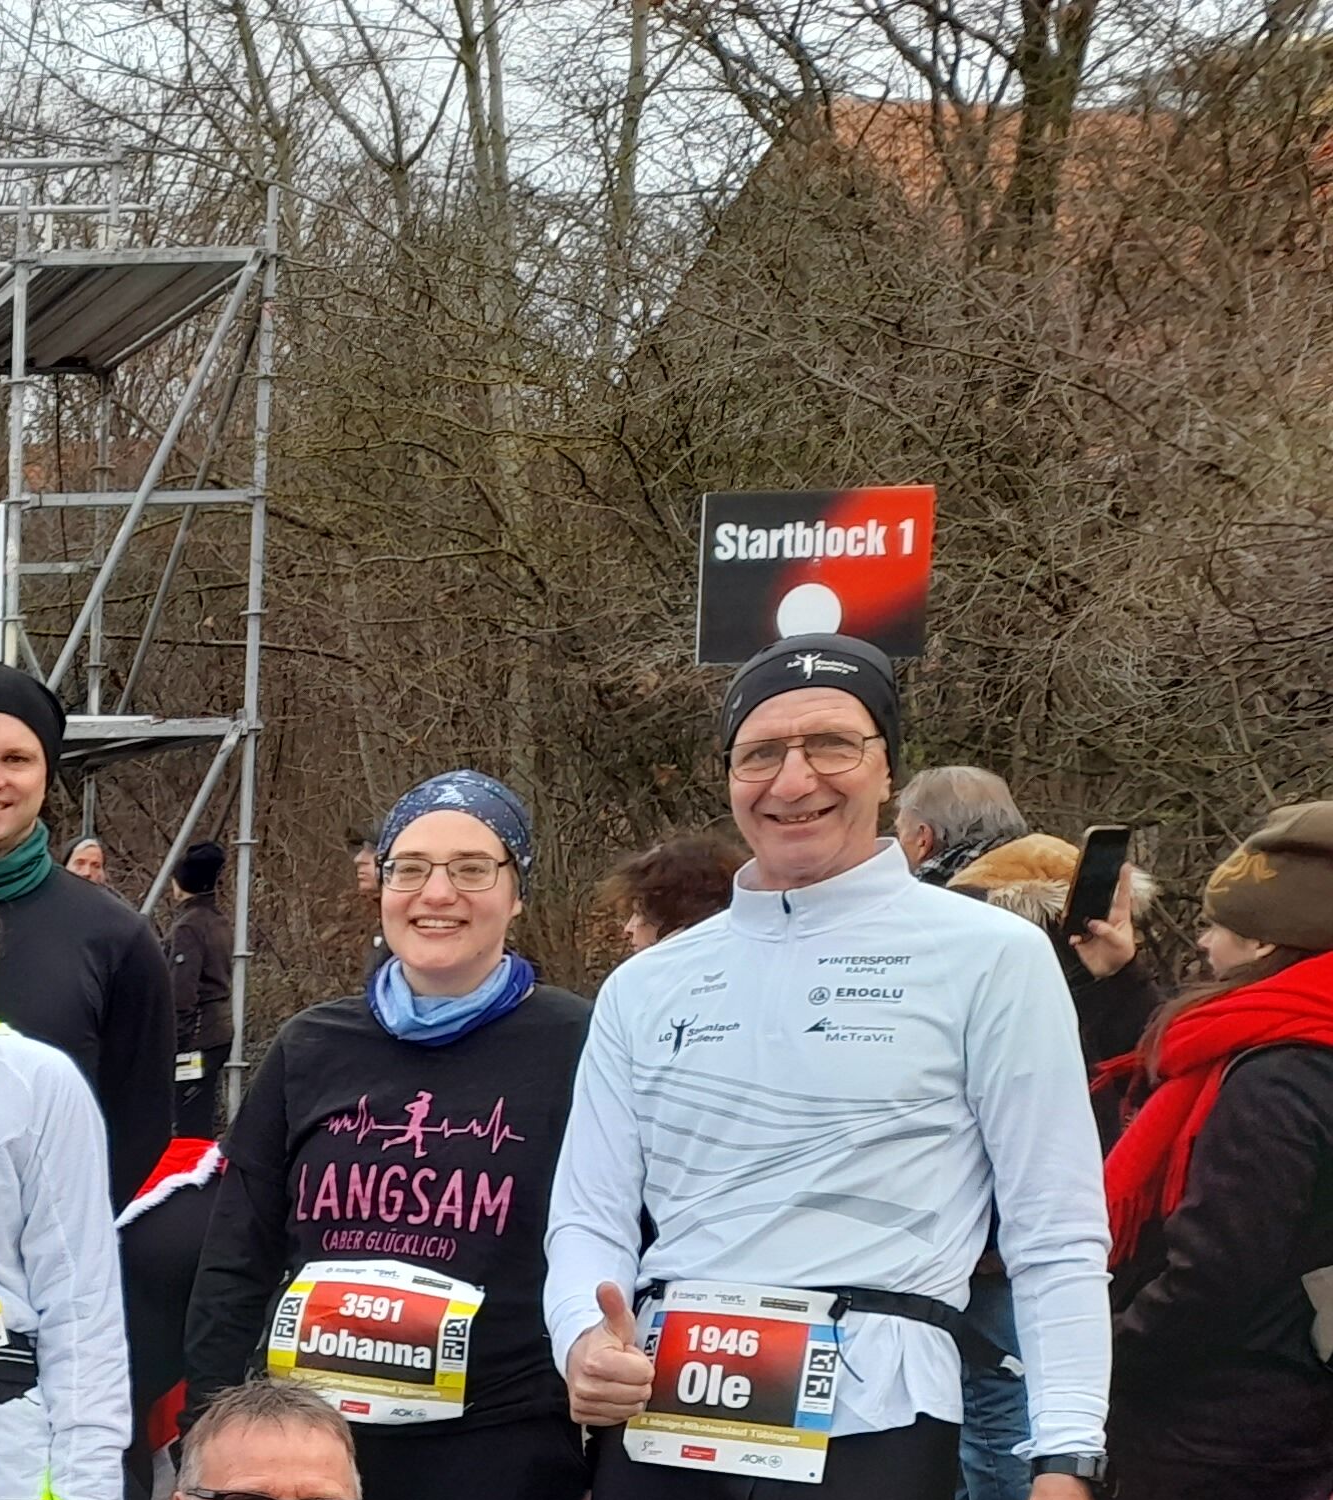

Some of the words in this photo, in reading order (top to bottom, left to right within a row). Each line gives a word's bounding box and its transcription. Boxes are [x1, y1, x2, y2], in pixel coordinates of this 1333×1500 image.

[714, 519, 888, 561] Startblock
[899, 518, 915, 555] 1
[828, 956, 912, 966] INTERSPORT
[835, 987, 905, 999] EROGLU
[658, 1031, 673, 1043] LG
[825, 1032, 895, 1044] MeTraVit
[296, 1162, 514, 1236] LANGSAM
[322, 1229, 363, 1252] (ABER
[365, 1227, 457, 1261] GLÜCKLICH)
[339, 1292, 405, 1324] 3591
[299, 1325, 432, 1370] Johanna
[686, 1324, 760, 1357] 1946
[676, 1361, 752, 1409] Ole
[739, 1453, 768, 1465] AOK
